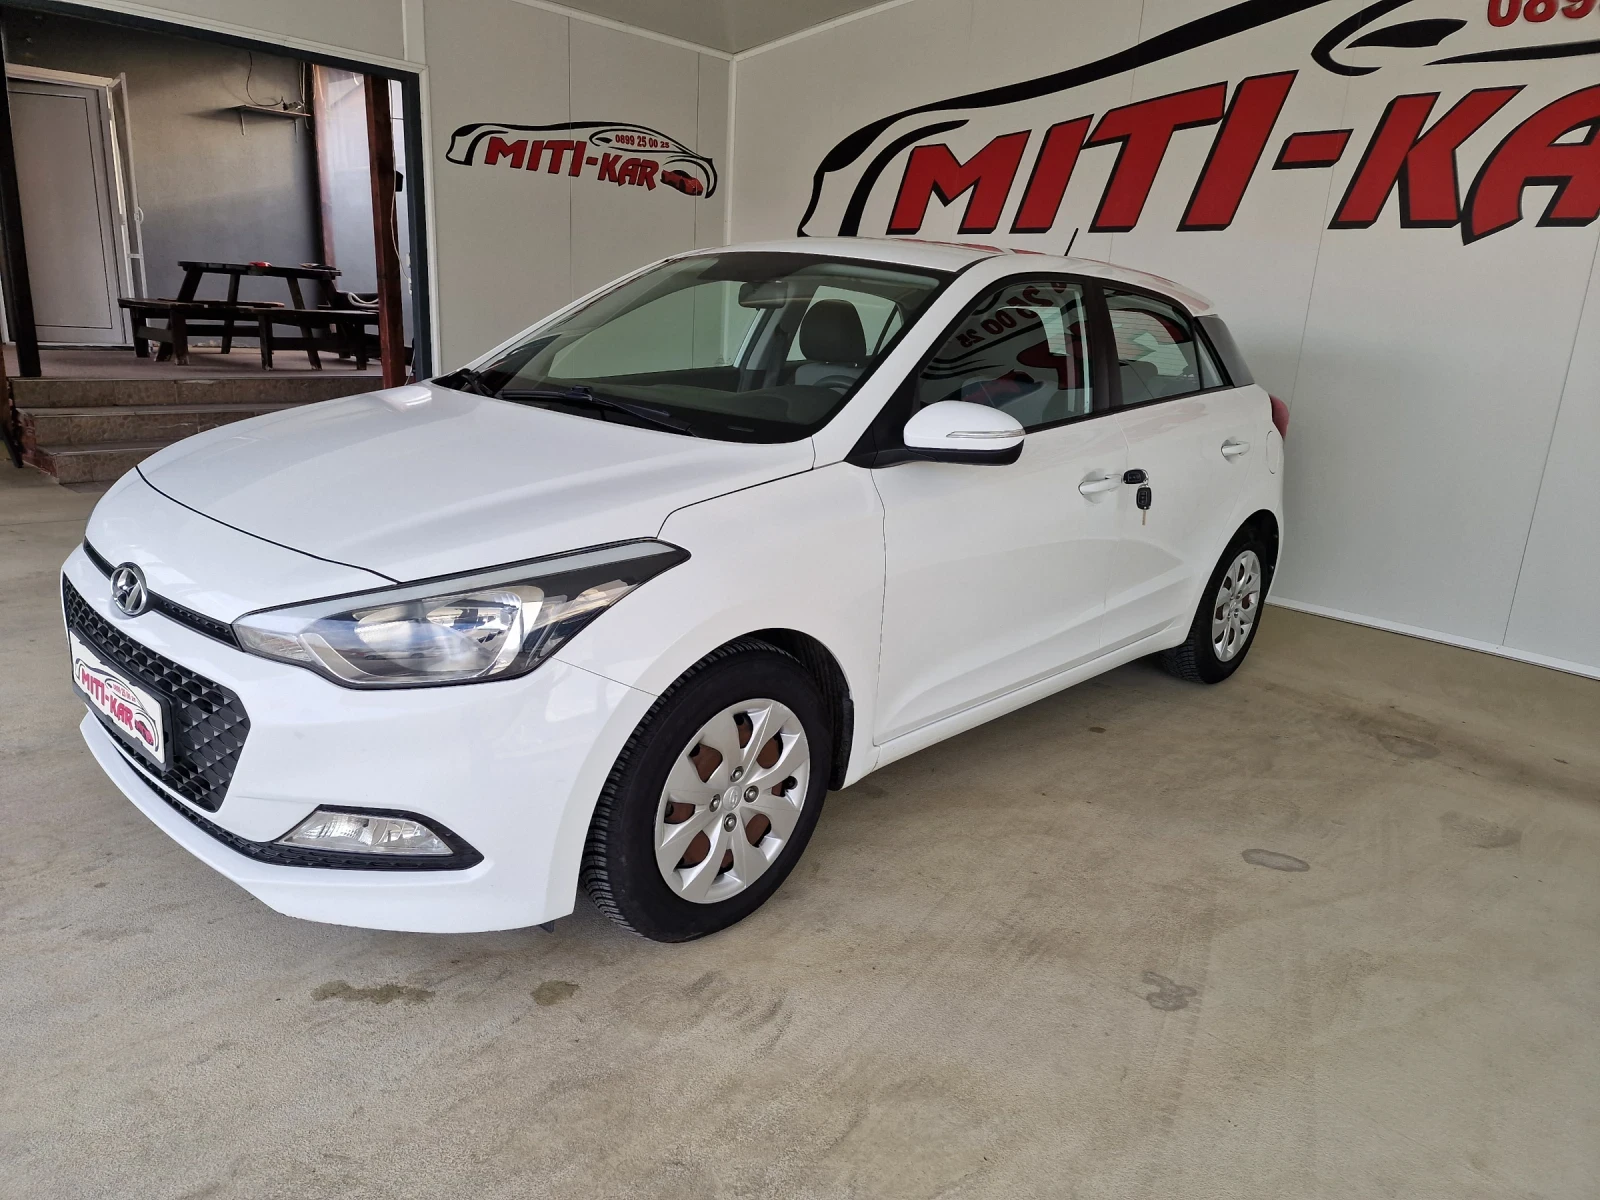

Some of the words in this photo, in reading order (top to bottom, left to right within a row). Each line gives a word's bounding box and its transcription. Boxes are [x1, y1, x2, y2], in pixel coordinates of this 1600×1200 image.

[484, 136, 660, 190] MITI-KAR
[615, 134, 635, 146] 0899
[637, 135, 647, 148] 25
[648, 137, 658, 148] 00
[81, 668, 133, 731] MITI-KAR
